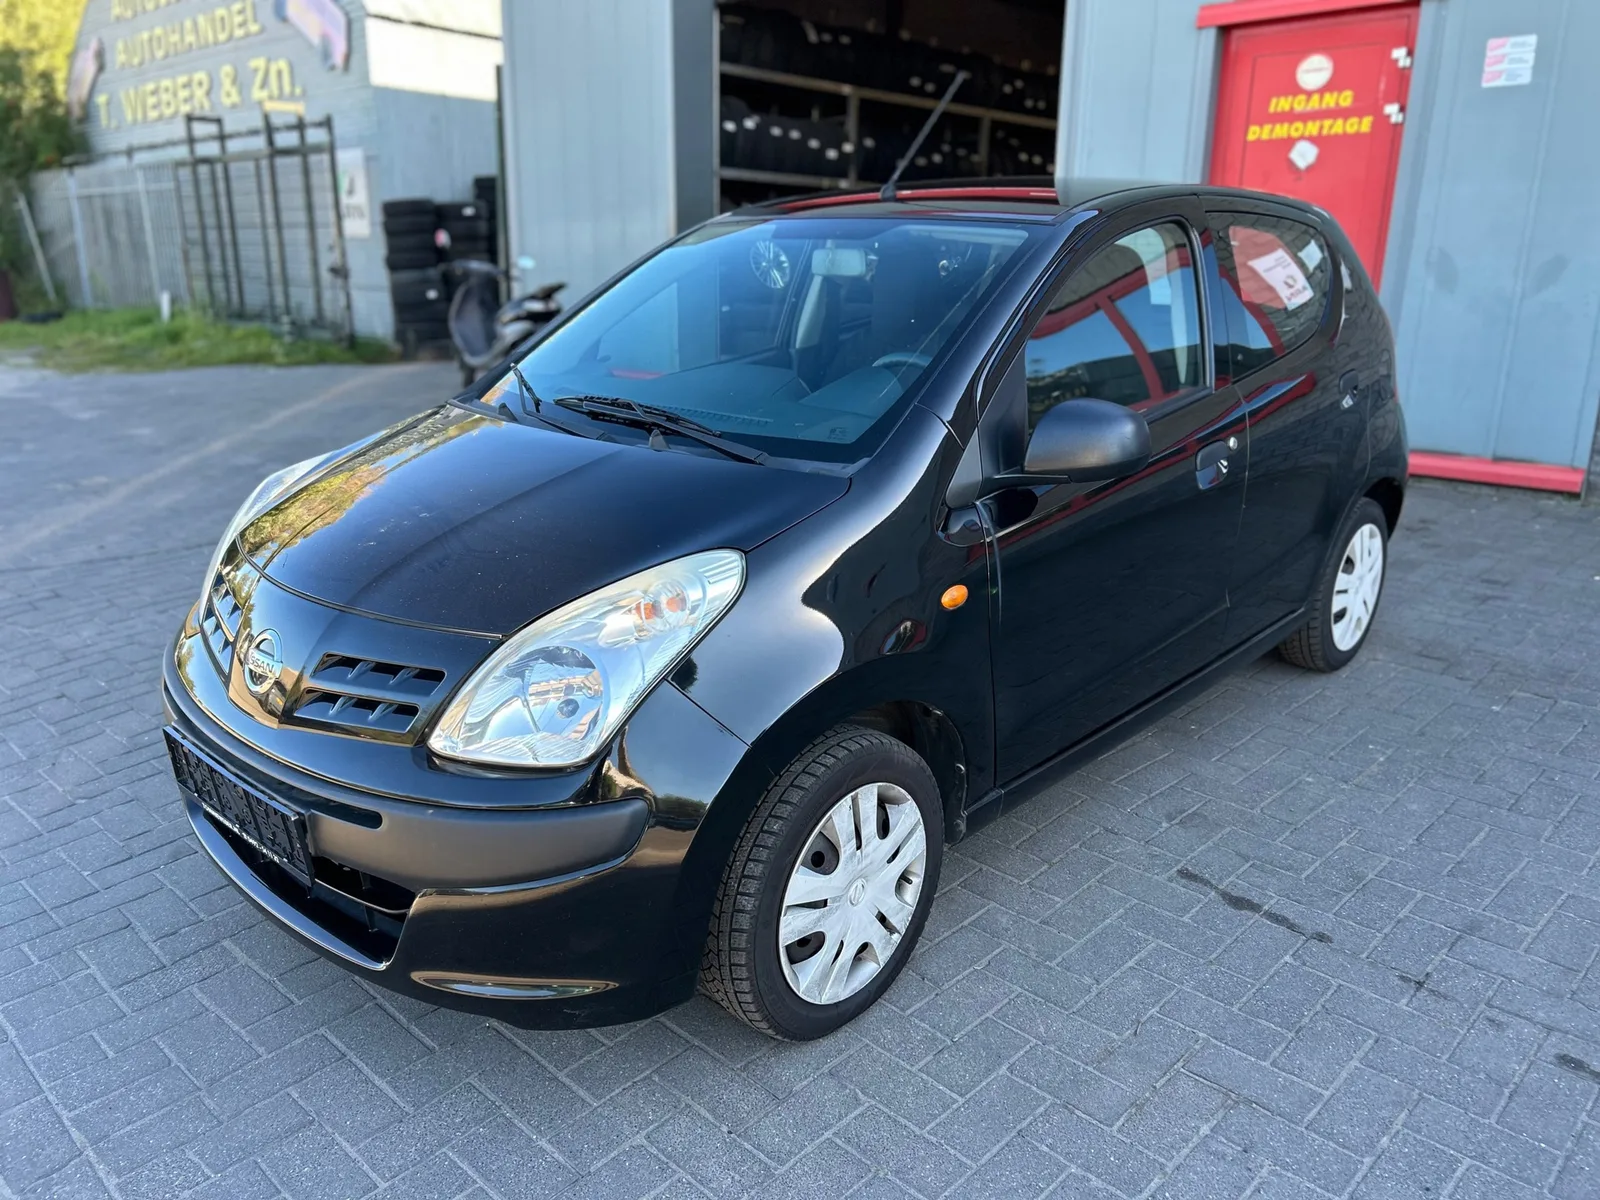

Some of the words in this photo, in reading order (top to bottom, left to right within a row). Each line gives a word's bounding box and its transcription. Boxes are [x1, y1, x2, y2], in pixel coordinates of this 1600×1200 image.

[115, 1, 264, 69] AUTOHANDEL
[95, 93, 118, 129] T.
[120, 70, 211, 125] WEBER
[219, 63, 242, 108] &
[249, 56, 303, 101] Zn.
[1268, 89, 1354, 113] INGANG
[1246, 115, 1374, 141] DEMONTAGE
[246, 649, 275, 673] ISSAN
